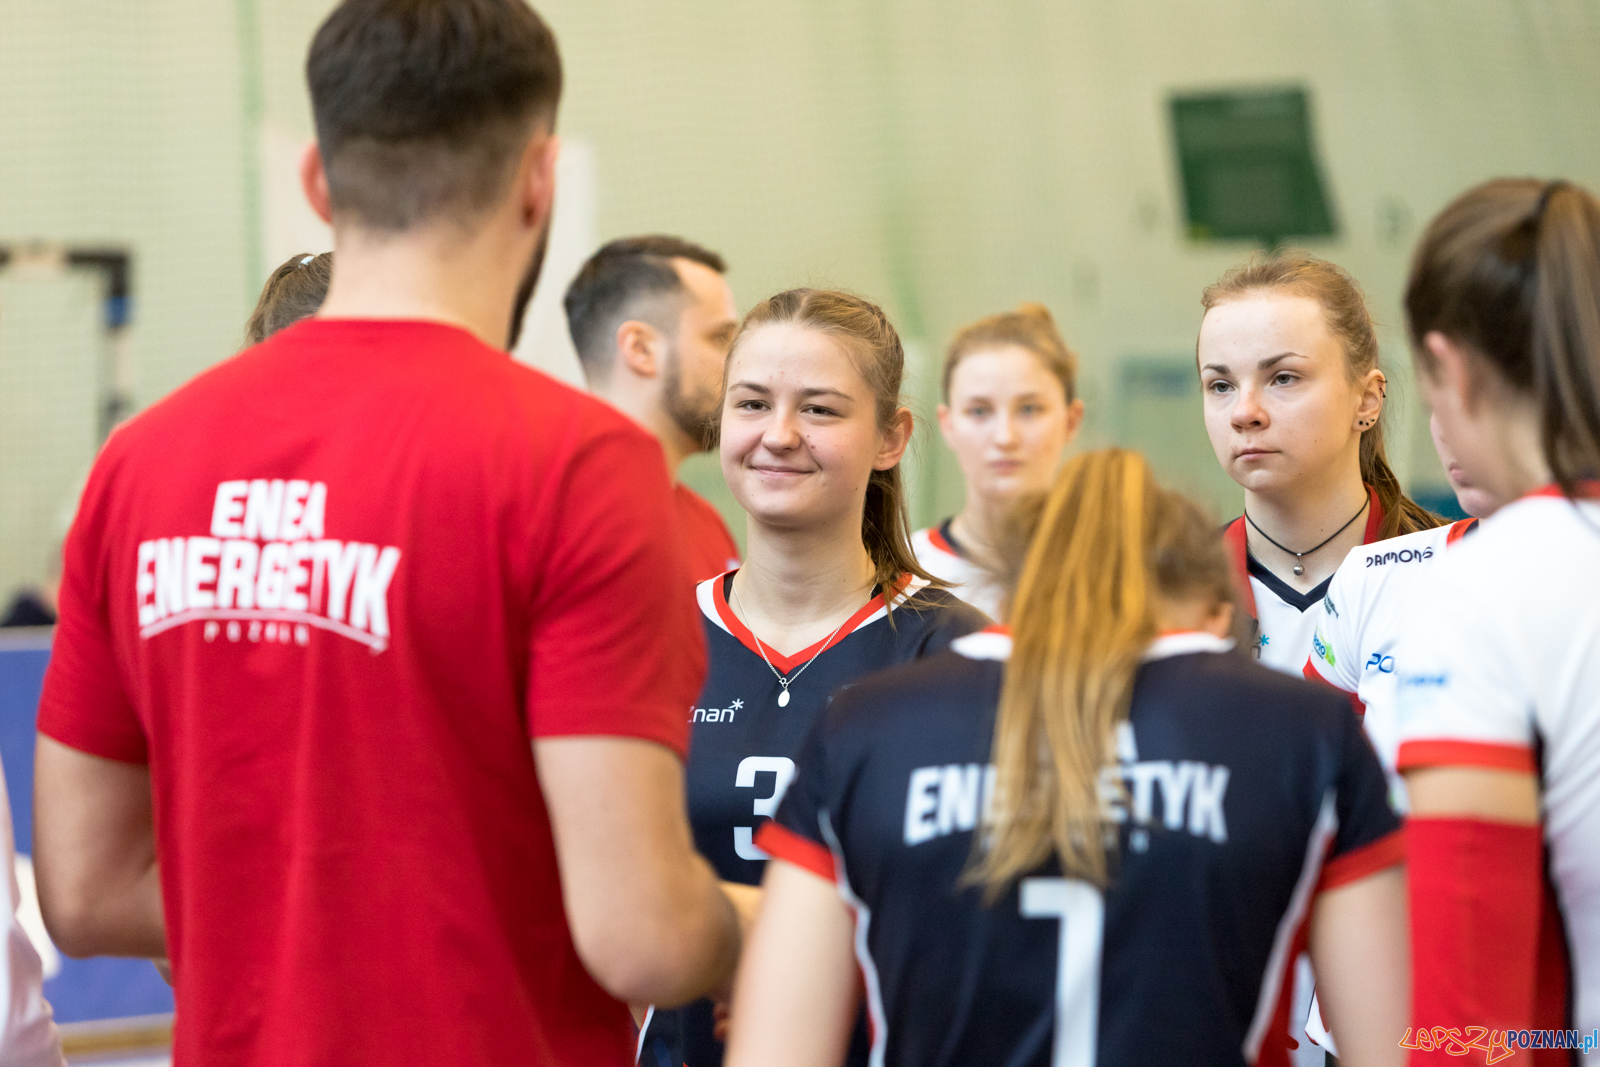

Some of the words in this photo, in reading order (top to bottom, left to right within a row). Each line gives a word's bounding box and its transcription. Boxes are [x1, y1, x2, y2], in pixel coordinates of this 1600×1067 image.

[210, 479, 328, 540] ENEA
[136, 536, 401, 640] ENERGETYK
[733, 756, 796, 861] 3
[1019, 876, 1105, 1067] 7
